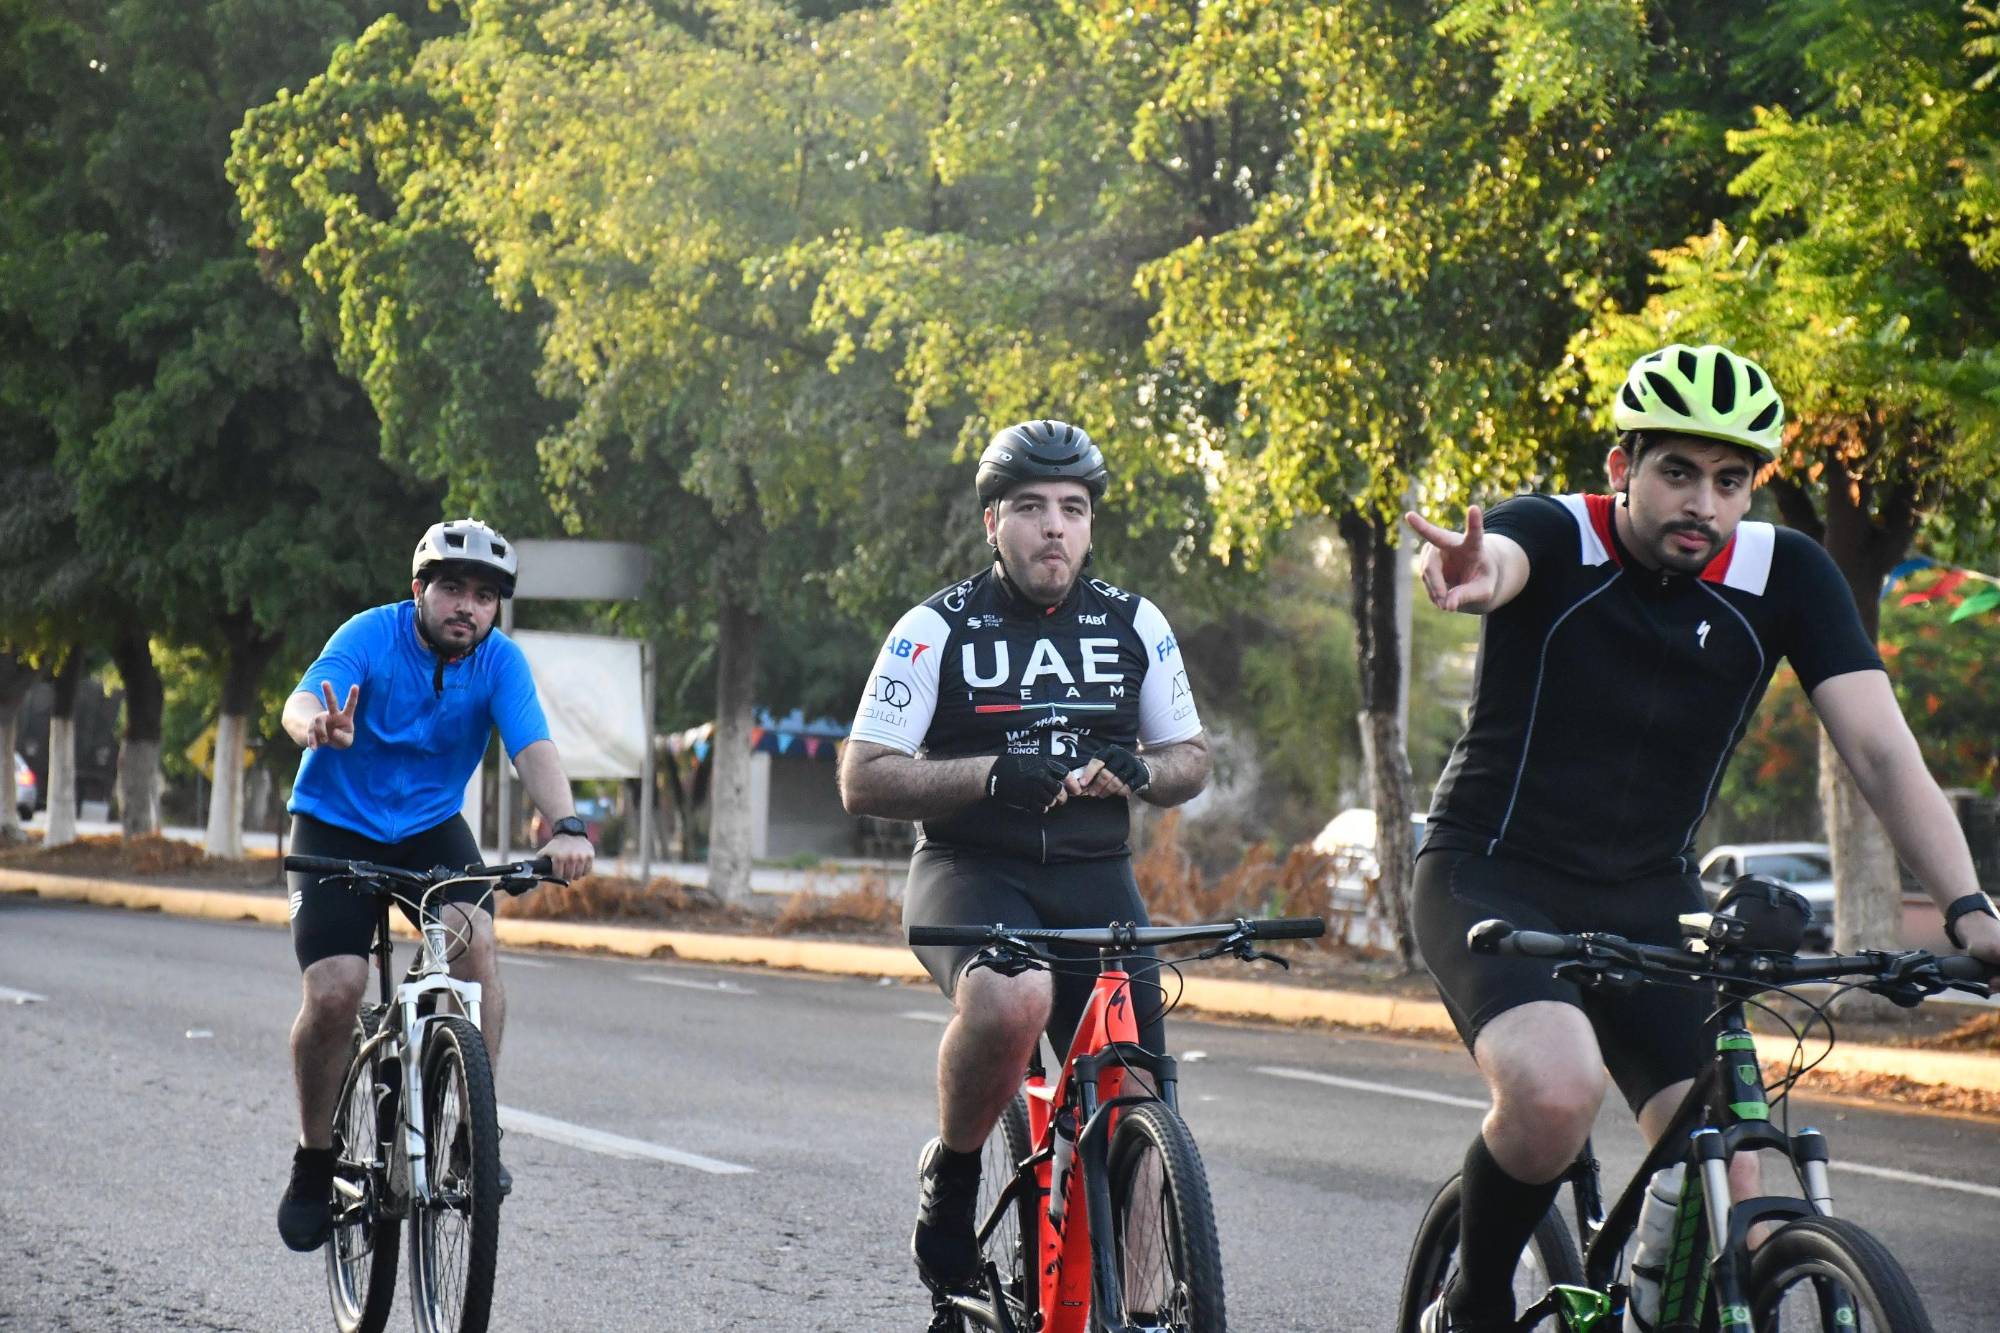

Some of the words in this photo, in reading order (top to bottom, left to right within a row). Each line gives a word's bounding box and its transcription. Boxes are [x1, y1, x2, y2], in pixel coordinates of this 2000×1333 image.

[943, 580, 974, 612] G42
[1078, 614, 1103, 626] FAB
[888, 636, 913, 658] AB
[1156, 634, 1178, 662] FA
[961, 638, 1125, 688] UAE
[967, 685, 1125, 701] TEAM
[1005, 747, 1040, 755] ADNOC
